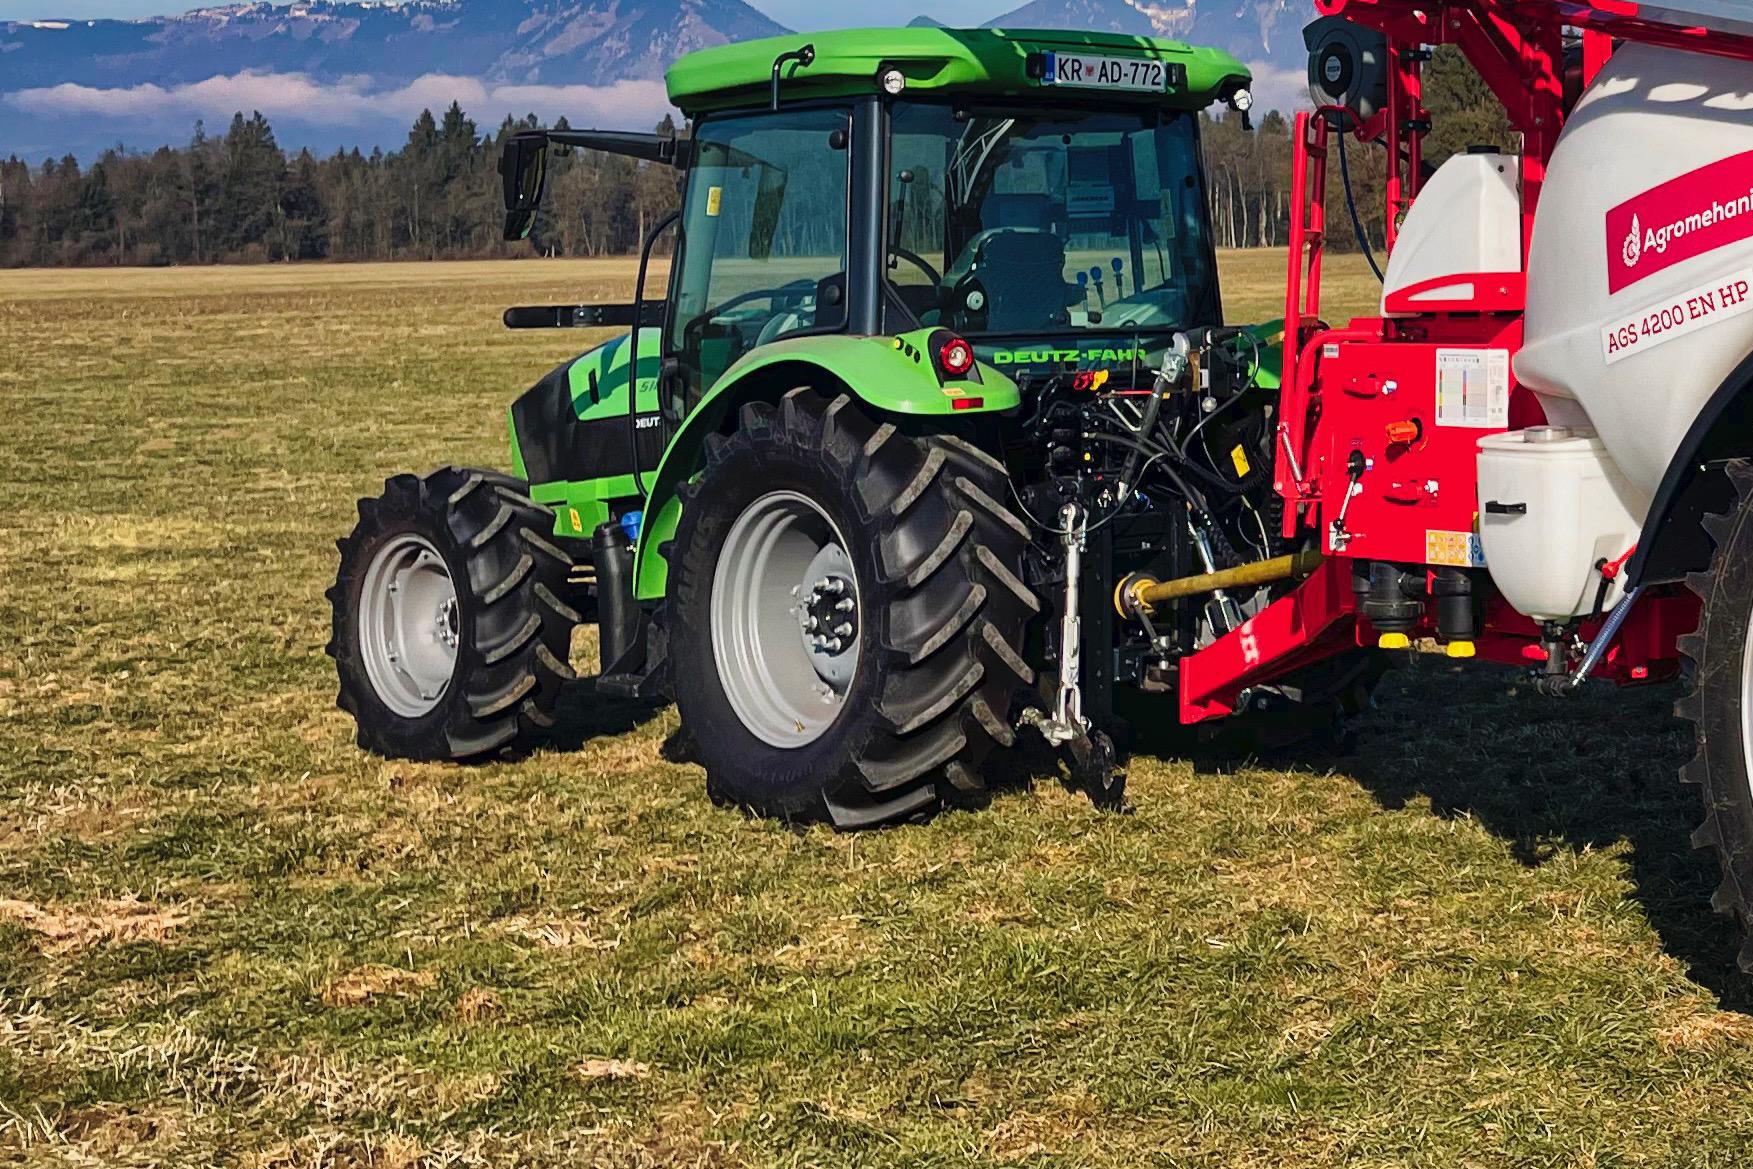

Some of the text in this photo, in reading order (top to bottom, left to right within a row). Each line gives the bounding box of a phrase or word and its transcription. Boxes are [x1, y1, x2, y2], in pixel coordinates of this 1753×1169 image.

[1058, 57, 1161, 86] KR AD-772
[1608, 280, 1749, 354] AGS 4200 EN HP
[994, 348, 1146, 365] DEUTZ-FAHR
